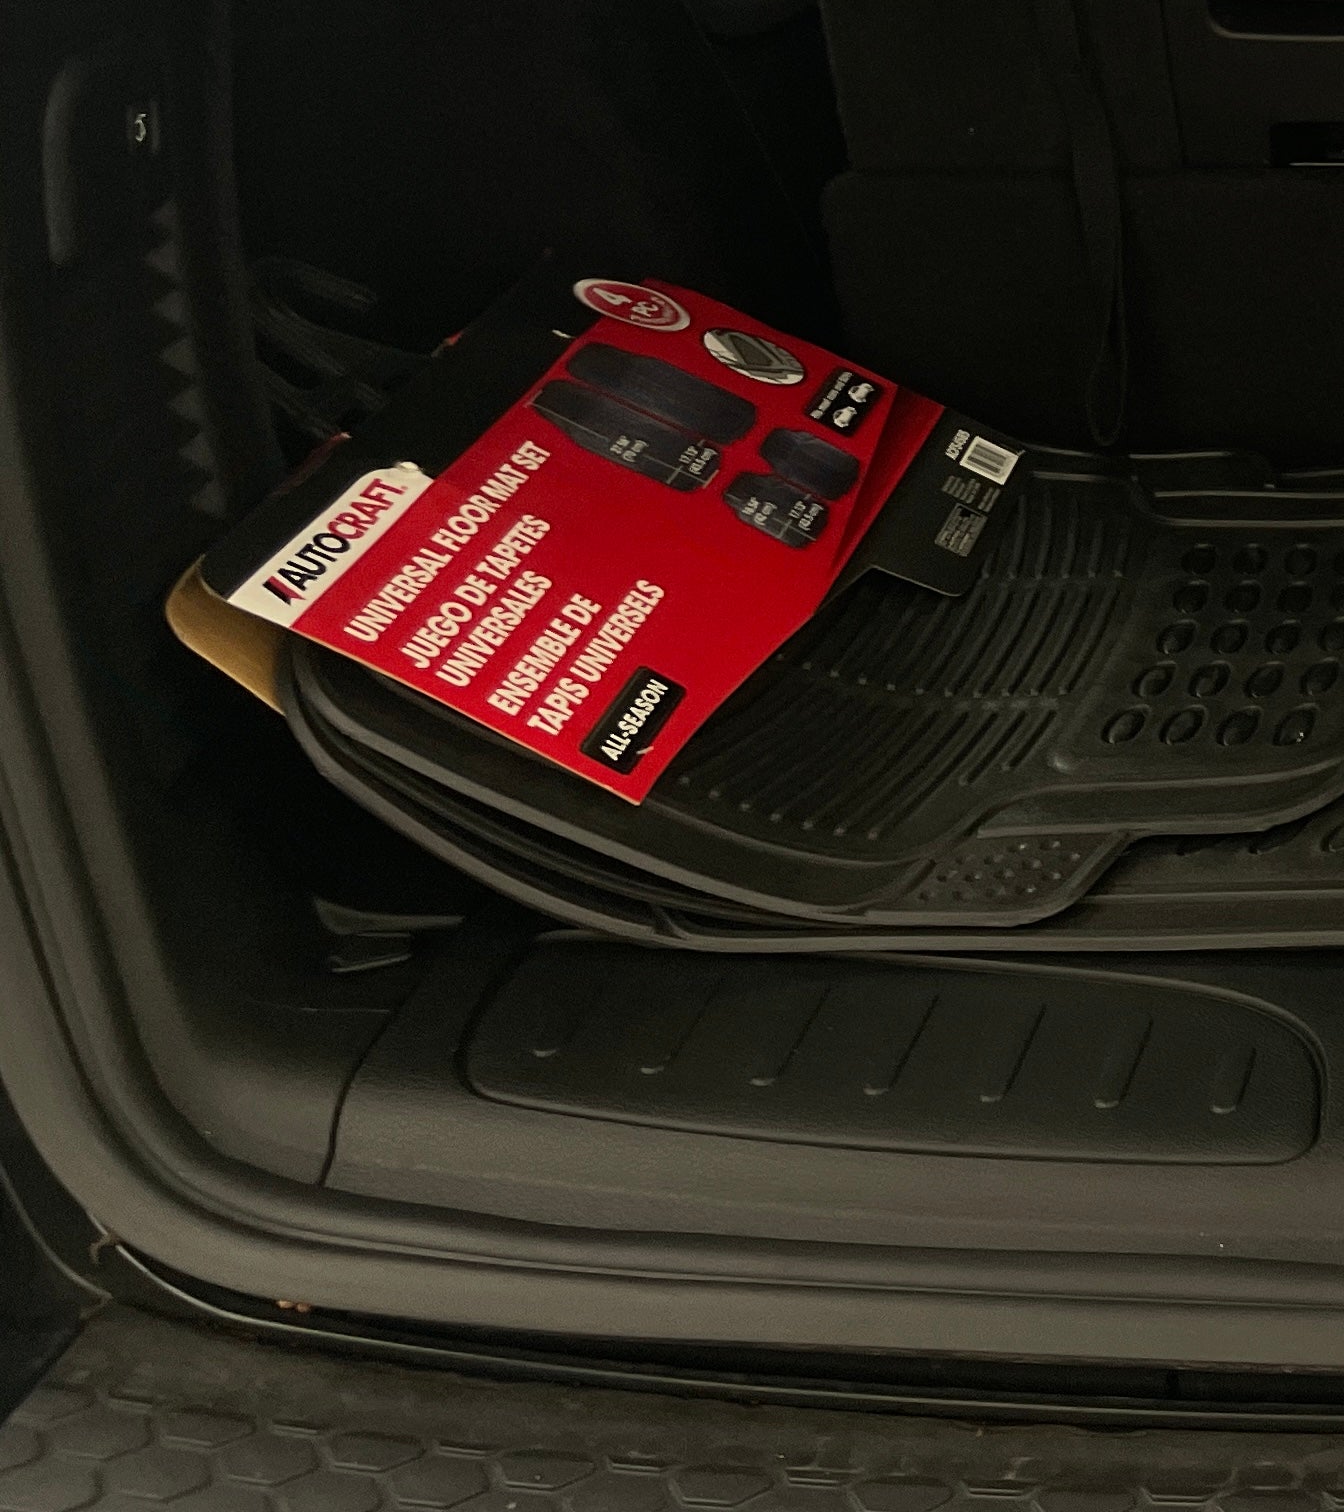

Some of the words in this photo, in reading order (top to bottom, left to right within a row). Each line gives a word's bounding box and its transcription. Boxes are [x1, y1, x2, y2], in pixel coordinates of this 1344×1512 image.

[592, 287, 633, 307] 4
[277, 478, 406, 592] AUTOCRAFT
[343, 547, 454, 642] UNIVERSAL
[431, 494, 502, 552] FLOOR
[479, 463, 530, 502] MAT
[510, 440, 551, 471] SET
[475, 514, 551, 580] TAPETES
[400, 601, 473, 669] JUEGO
[435, 570, 553, 687] UNIVERSALES
[453, 574, 498, 607] DE
[486, 618, 582, 716] ENSEMBLE
[561, 592, 602, 626] DE
[527, 677, 590, 736] TAPIS
[569, 579, 665, 683] UNIVERSELS
[601, 679, 669, 761] ALL-SEASON
